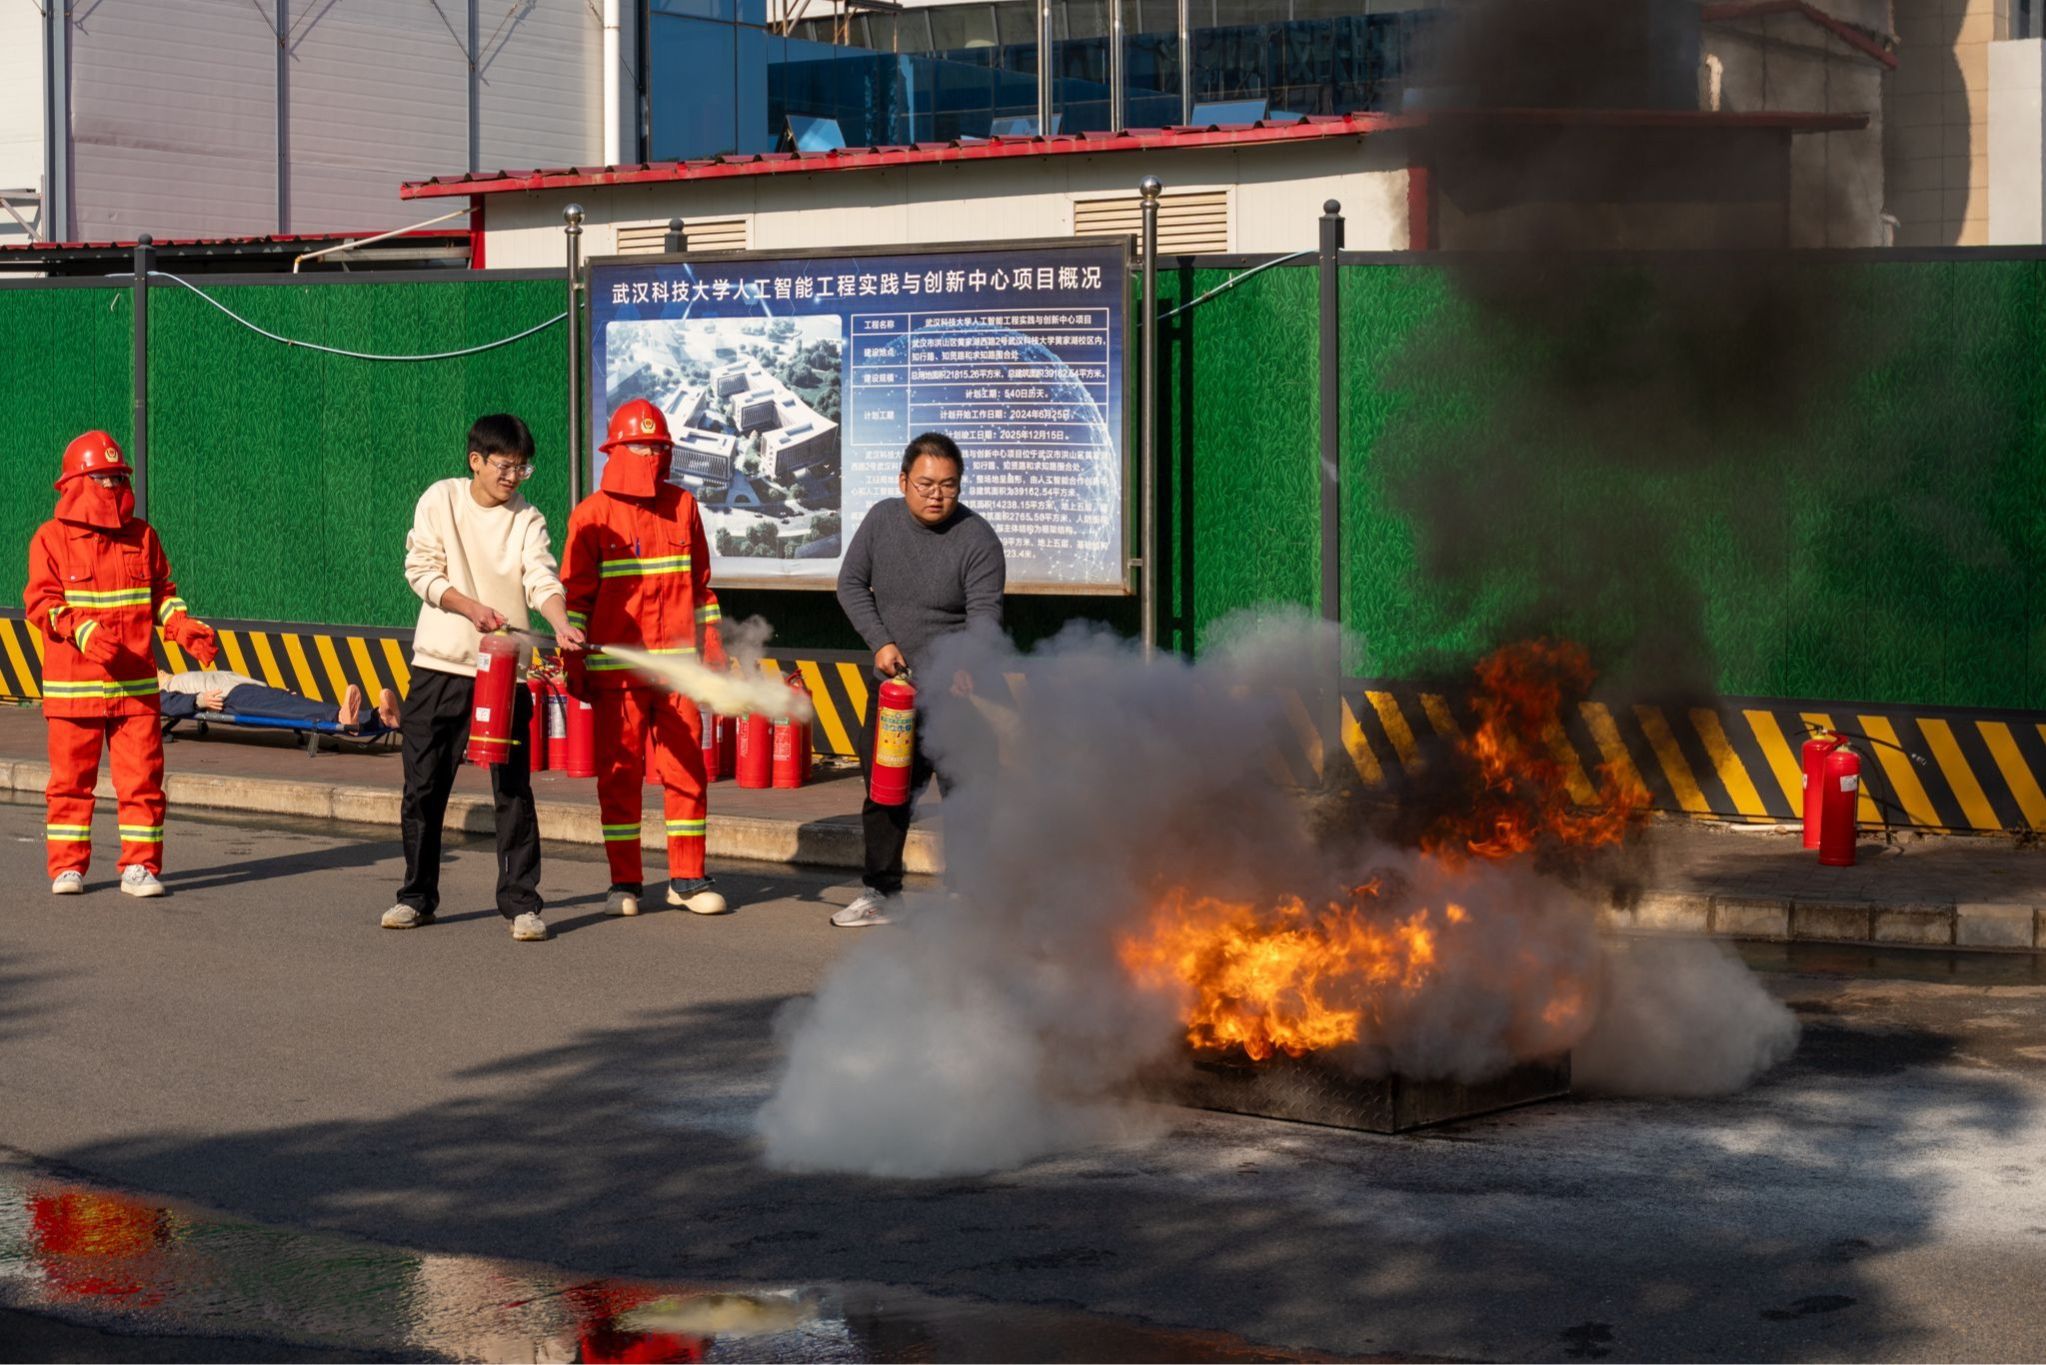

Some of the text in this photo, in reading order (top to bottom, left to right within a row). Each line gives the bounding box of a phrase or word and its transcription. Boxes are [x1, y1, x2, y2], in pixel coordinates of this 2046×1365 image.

[612, 266, 1102, 304] 武汉科技大学人工智能工程实践与创新中心项目概况
[864, 320, 895, 330] 工程名称
[925, 315, 1092, 328] 武汉科技大学人工智能工程实践与创新中心项目
